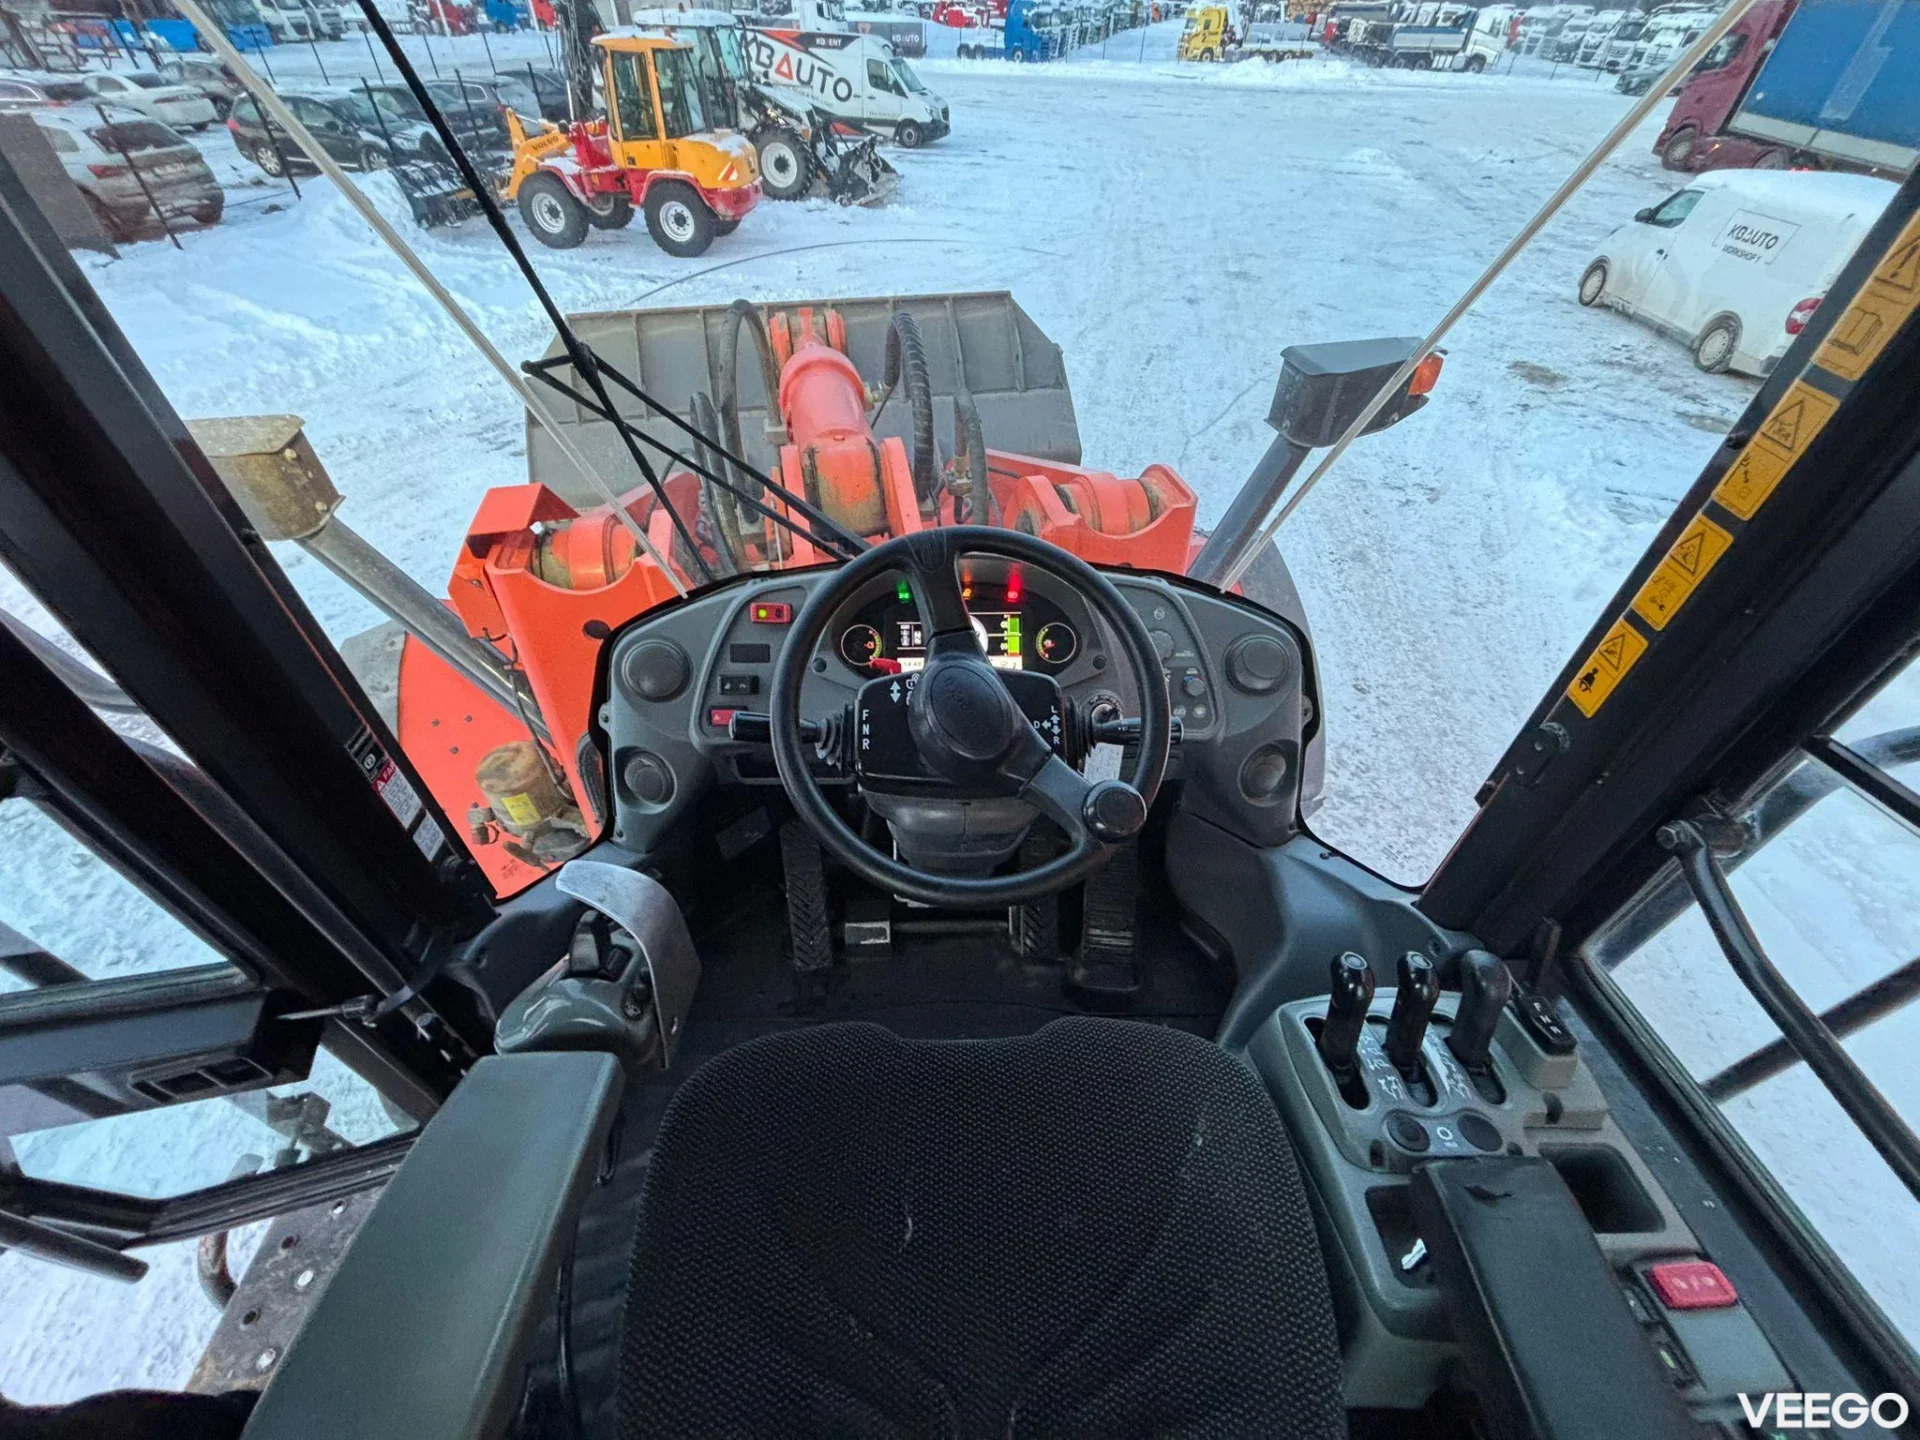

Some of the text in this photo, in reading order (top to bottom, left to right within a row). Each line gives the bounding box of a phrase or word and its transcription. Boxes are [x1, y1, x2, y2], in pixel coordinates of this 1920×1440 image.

[532, 135, 559, 151] VOLVO
[862, 709, 869, 720] F
[862, 724, 870, 735] N
[862, 739, 870, 750] R
